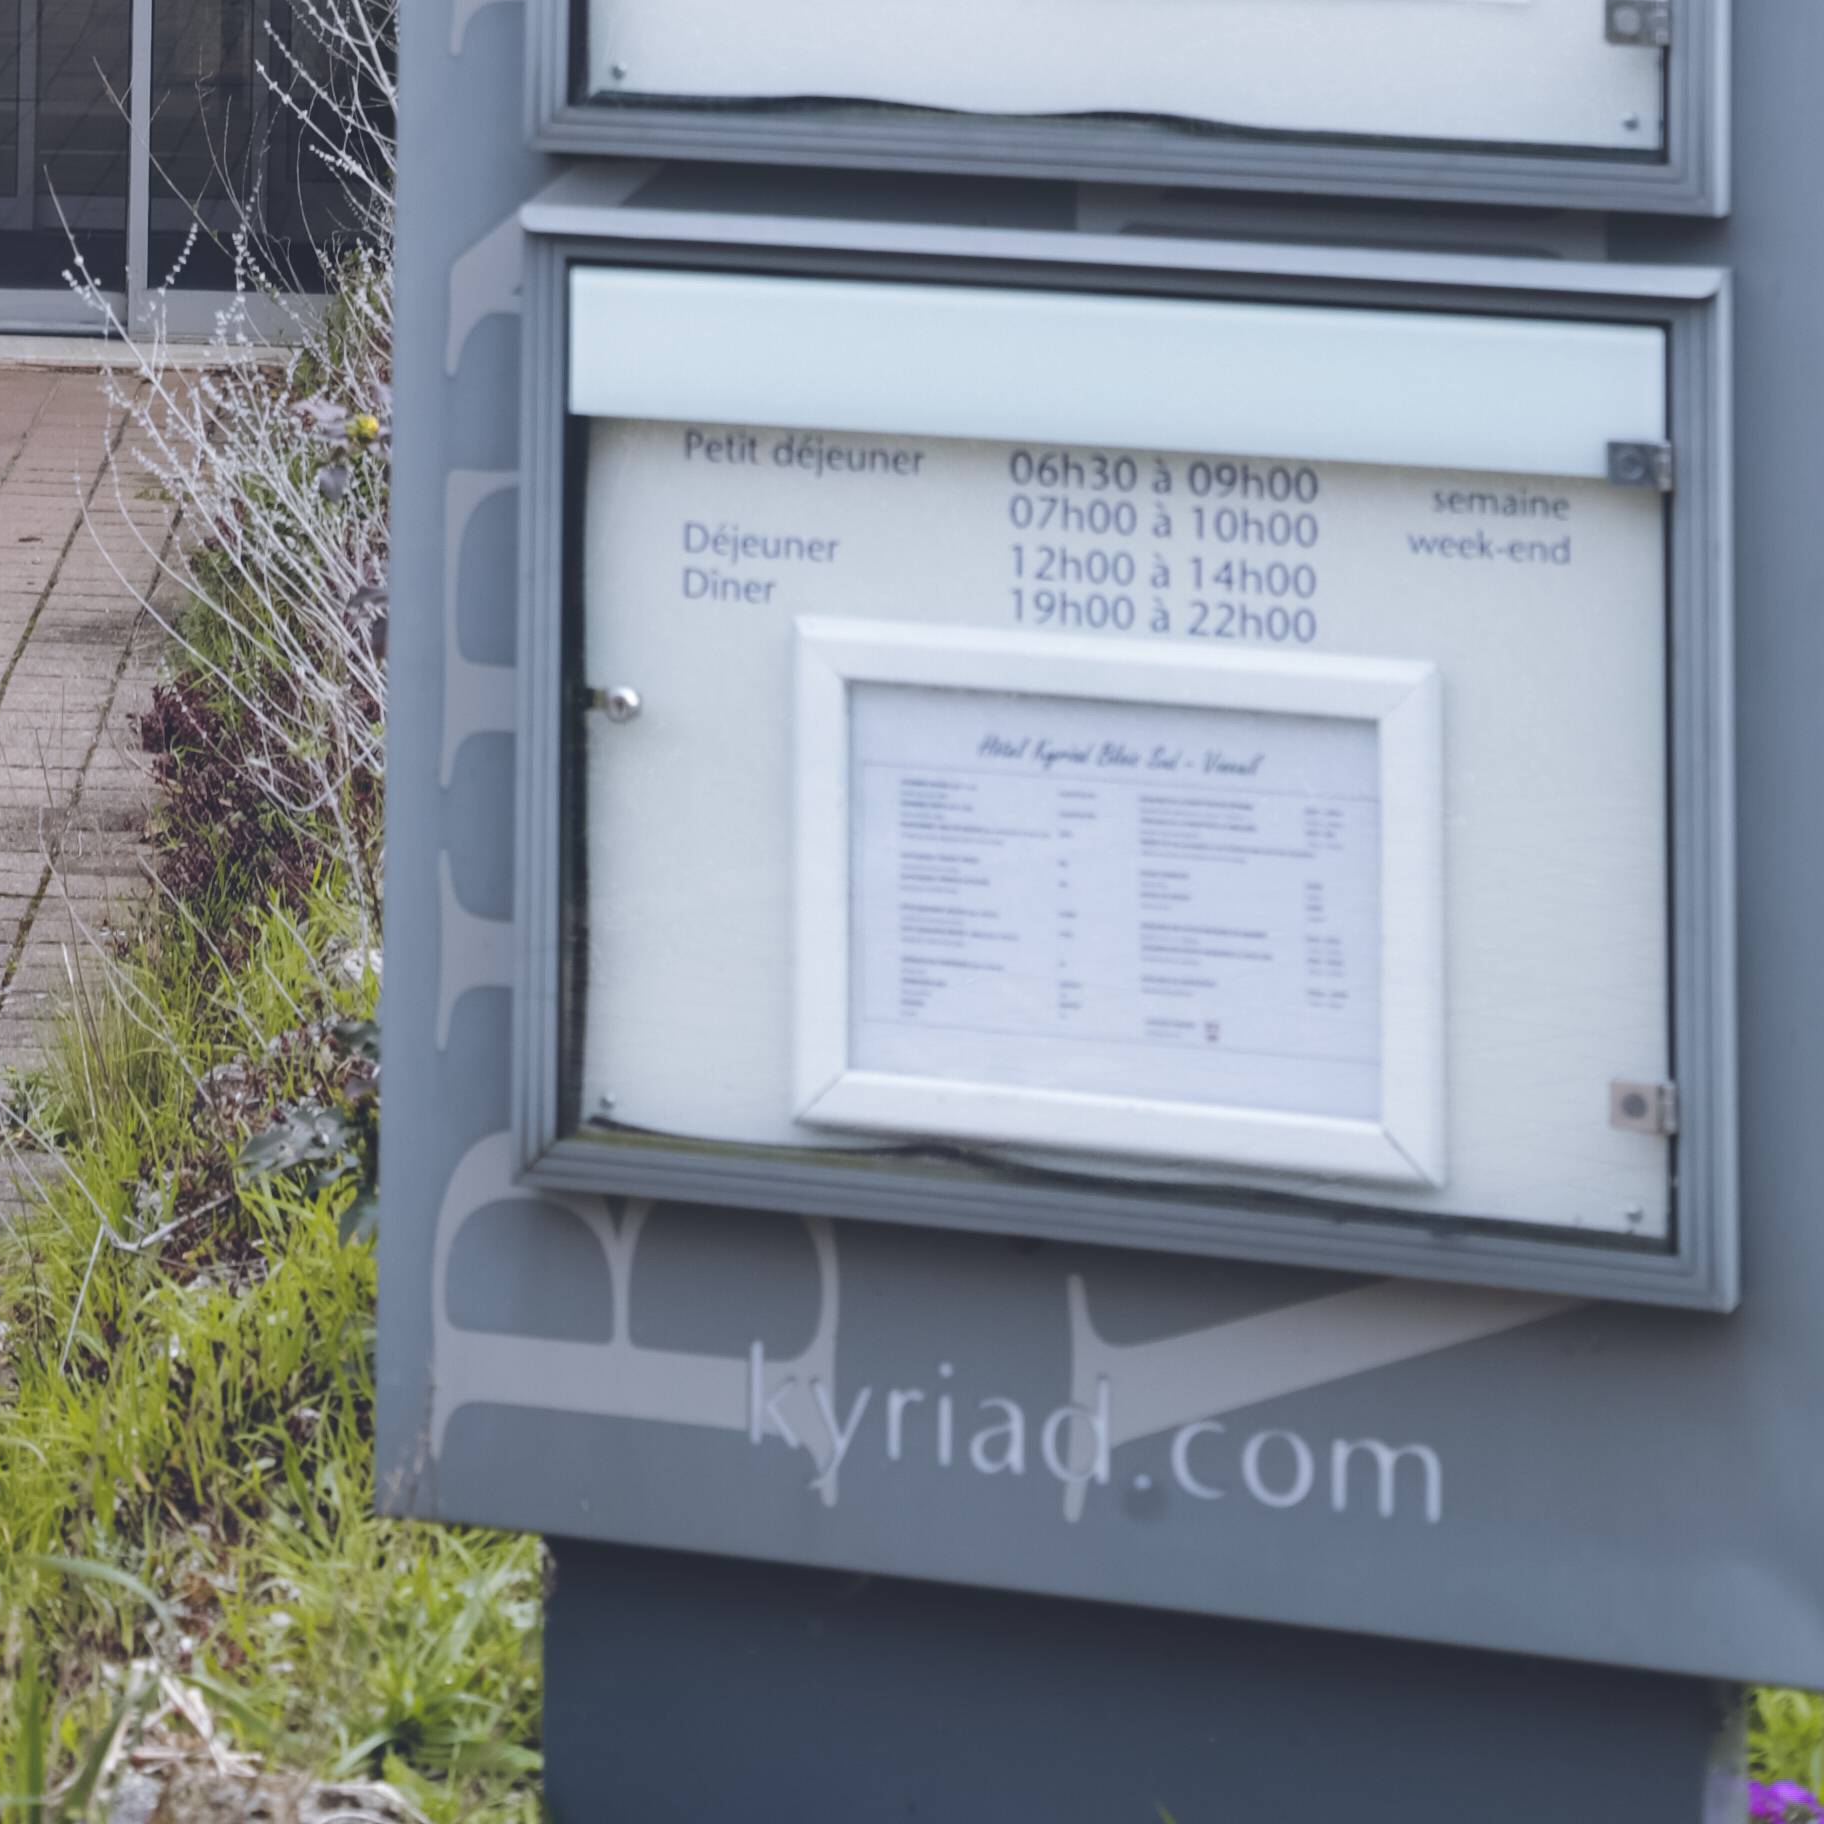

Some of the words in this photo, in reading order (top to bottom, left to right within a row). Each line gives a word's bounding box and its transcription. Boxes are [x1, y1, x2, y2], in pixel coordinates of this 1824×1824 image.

[683, 428, 759, 465] Petit
[772, 432, 924, 478] déjeuner
[1009, 449, 1138, 493] 06h30
[1150, 455, 1173, 495] à
[1187, 460, 1319, 504] 09h00
[1009, 493, 1138, 537] 07h00
[1150, 500, 1173, 539] à
[1191, 506, 1319, 549] 10h00
[1432, 487, 1571, 521] semaine
[682, 520, 840, 565] Déjeuner
[1405, 529, 1572, 566] week-end
[1011, 545, 1136, 587] 12h00
[1149, 552, 1171, 589] à
[1189, 557, 1317, 600] 14h00
[1011, 588, 1136, 631] 19h00
[1149, 597, 1171, 634] à
[1187, 600, 1317, 644] 22h00
[748, 1340, 1442, 1524] kyriad.com
